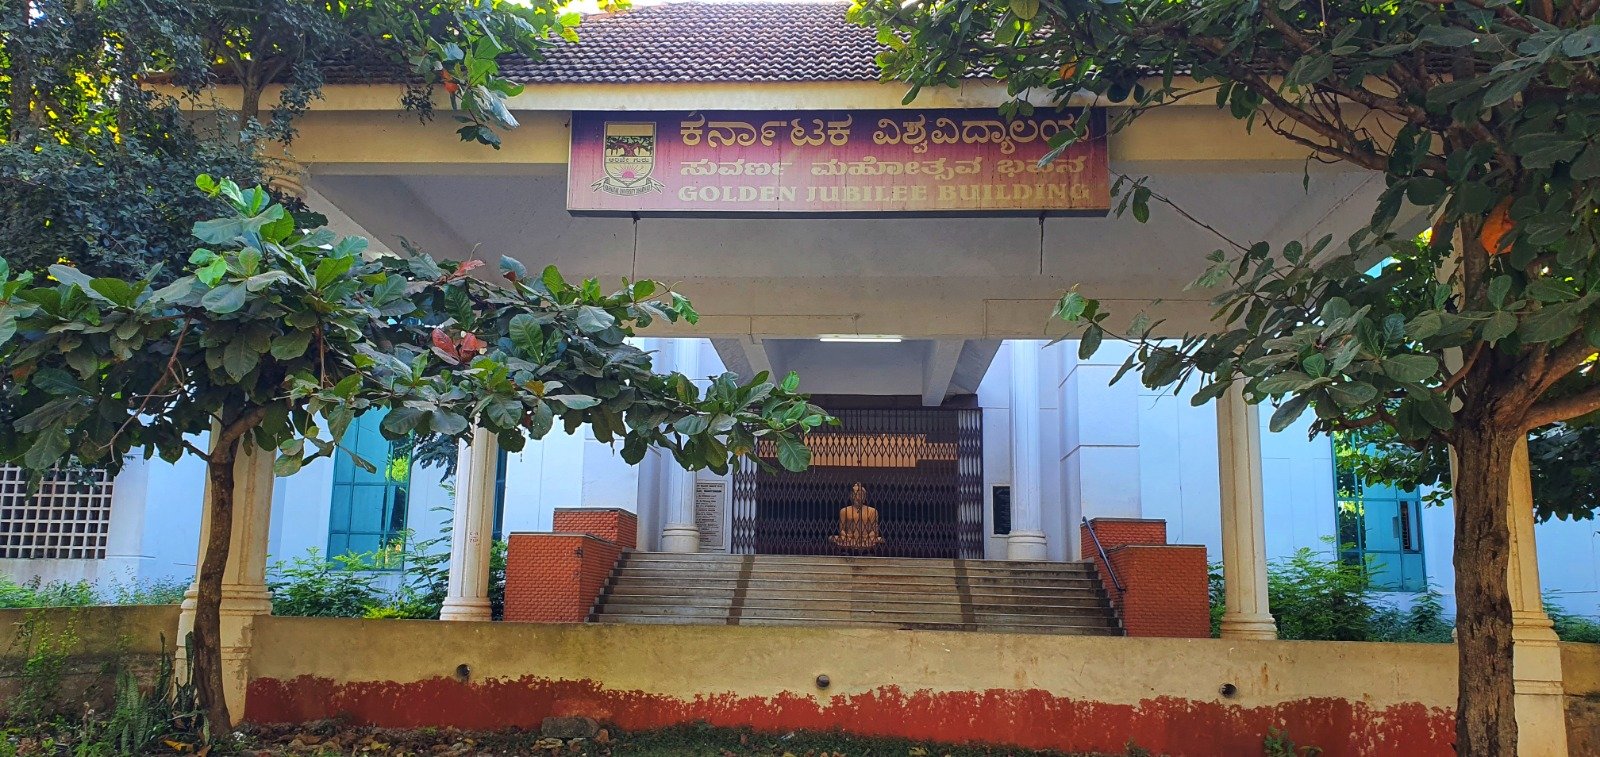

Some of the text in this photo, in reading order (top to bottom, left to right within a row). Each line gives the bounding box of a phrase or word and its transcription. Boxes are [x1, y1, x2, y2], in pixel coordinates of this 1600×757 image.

[680, 113, 1090, 154] ಕರ್ನಾಟಕ ವಿಶ್ವವಿದ್ಯಾಲಯ
[680, 156, 1087, 180] ಸುವರ್ಣ ಮಹೋತ್ಸವ ಭವನ
[678, 184, 1089, 202] GOLDEN JUBILEE BUILDING
